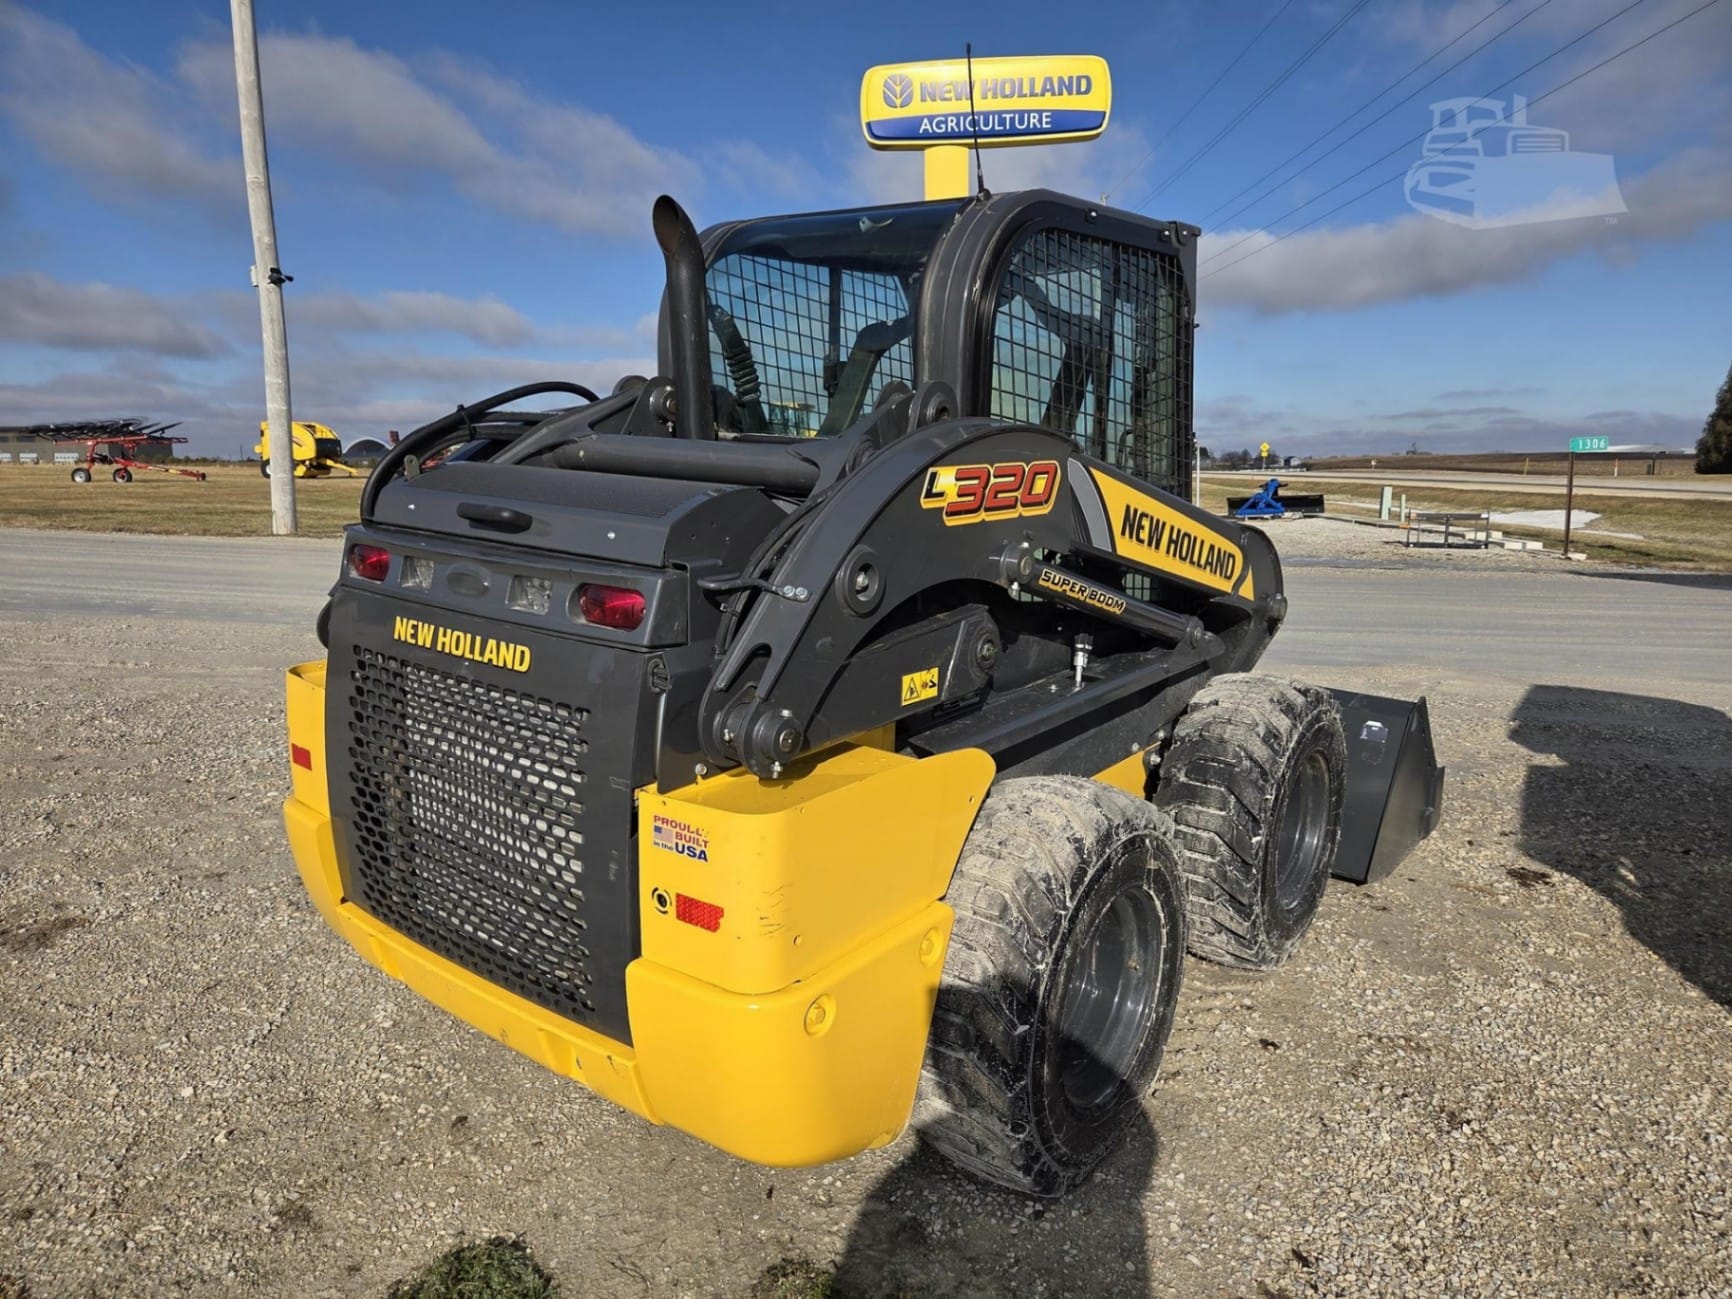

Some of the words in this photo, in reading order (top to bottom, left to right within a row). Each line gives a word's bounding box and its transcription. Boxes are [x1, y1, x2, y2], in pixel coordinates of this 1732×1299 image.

[920, 79, 975, 103] NEW
[980, 75, 1092, 100] HOLLAND
[919, 112, 1052, 134] AGRICULTURE
[1578, 438, 1606, 450] 1306
[922, 461, 1060, 524] L320
[1120, 503, 1166, 551] NEW
[1165, 524, 1236, 580] HOLLAND
[1040, 569, 1089, 599] SUPER
[1088, 587, 1126, 614] BOOM
[393, 615, 435, 649] NEW
[436, 626, 531, 673] HOLLAND
[674, 841, 708, 863] USA
[675, 831, 710, 849] BUILT
